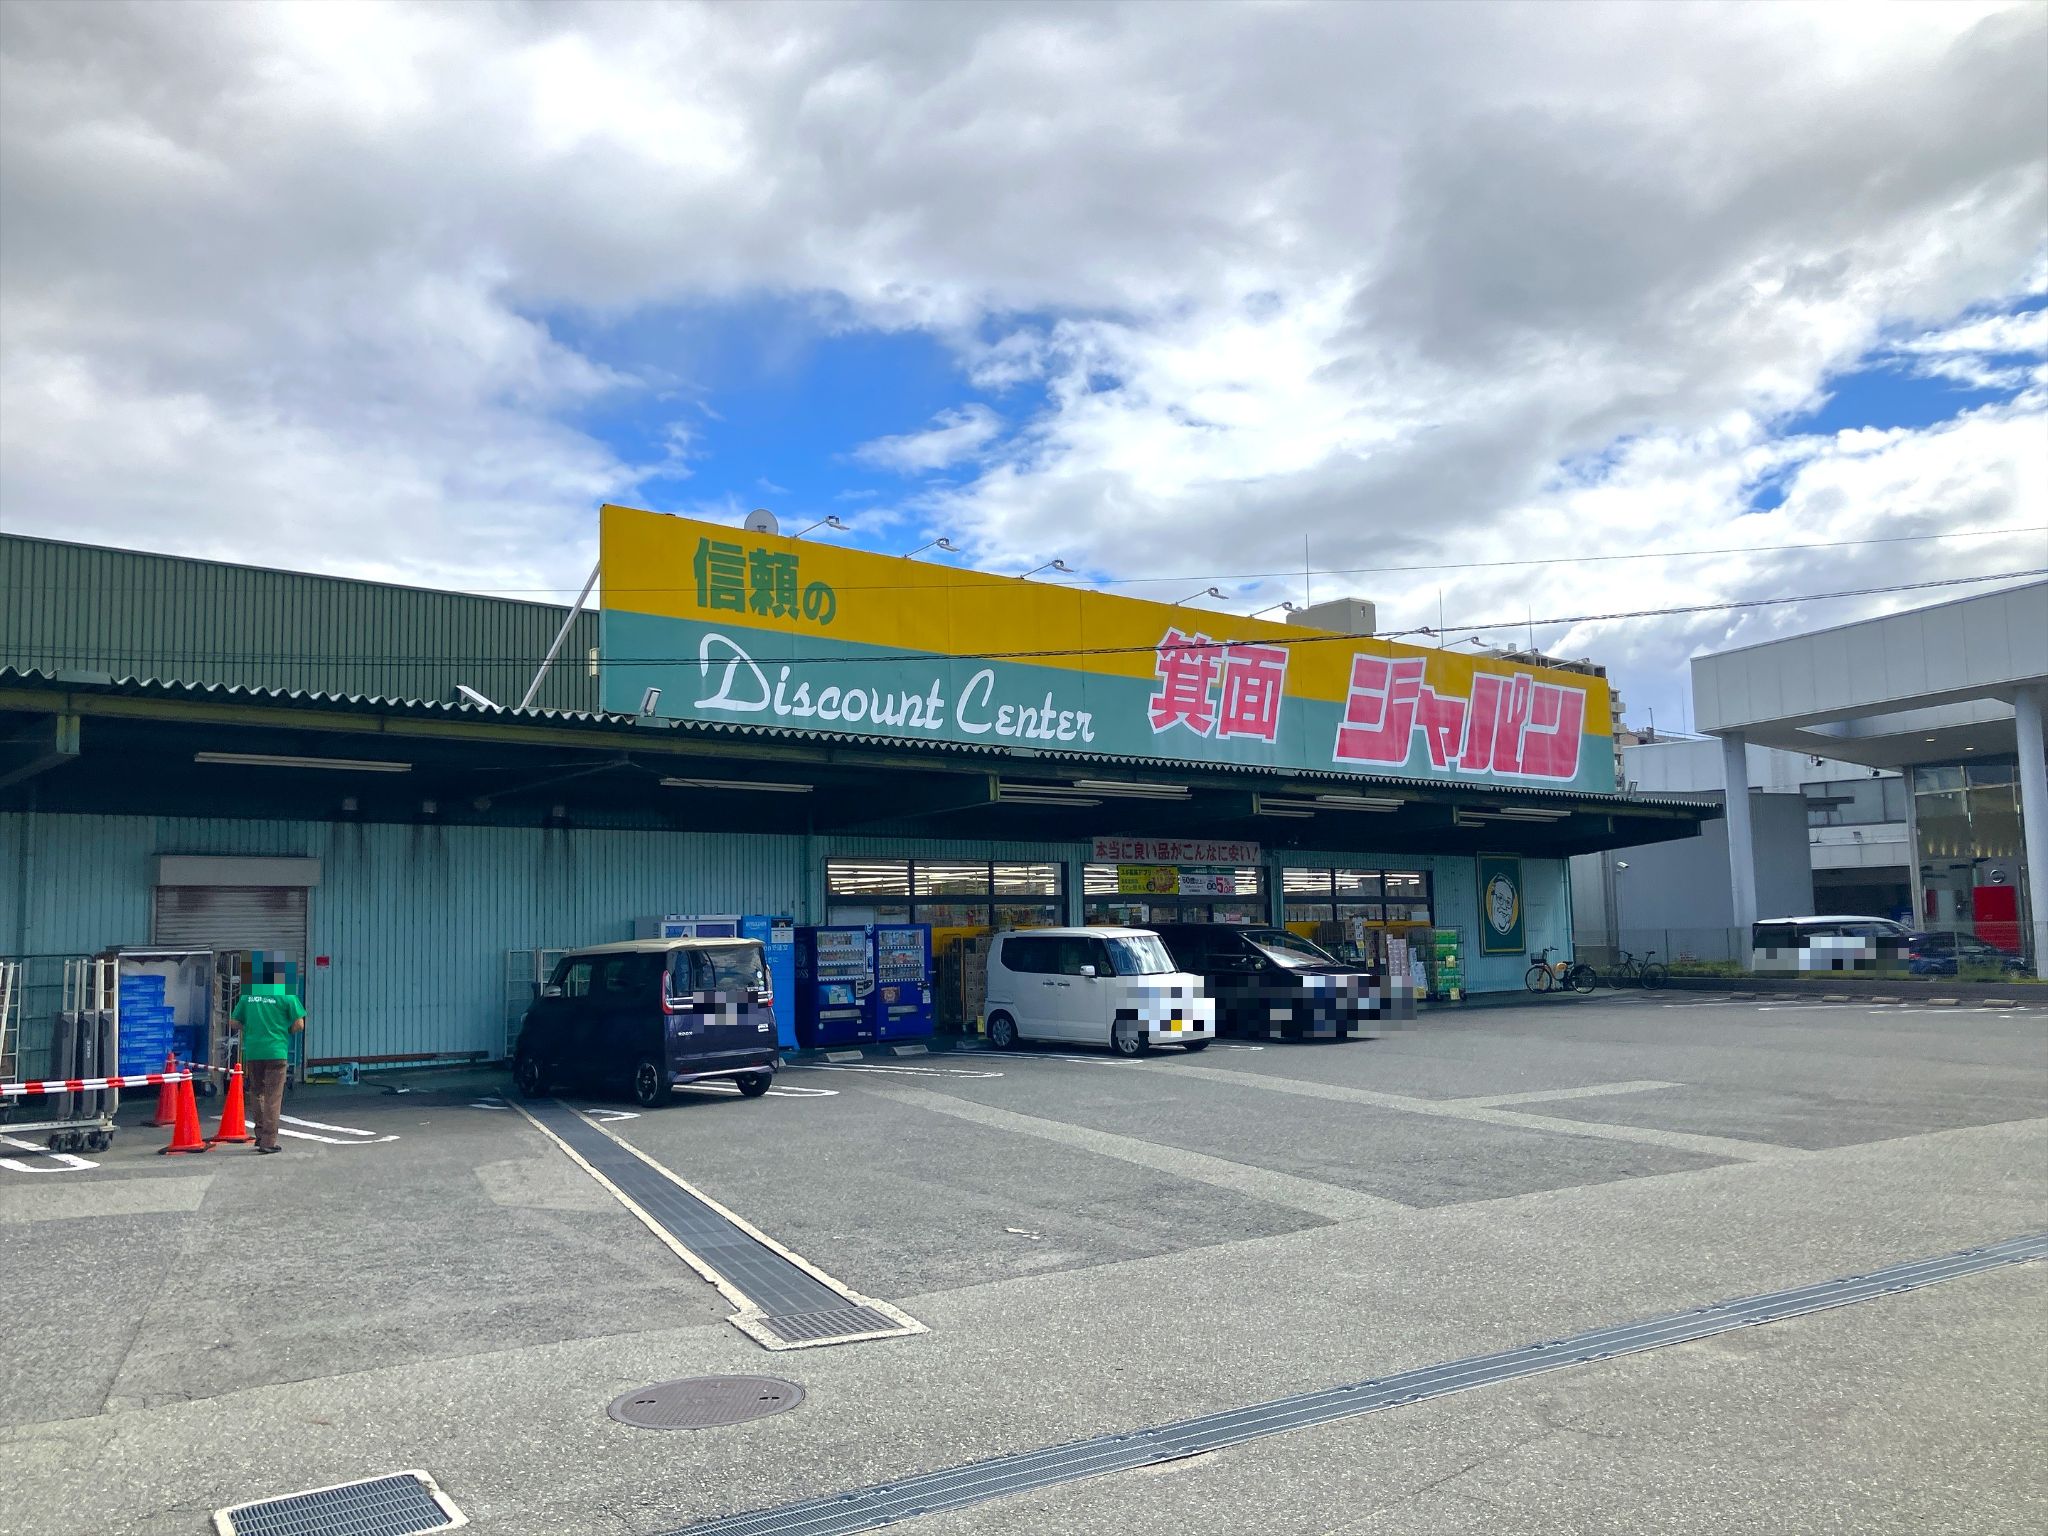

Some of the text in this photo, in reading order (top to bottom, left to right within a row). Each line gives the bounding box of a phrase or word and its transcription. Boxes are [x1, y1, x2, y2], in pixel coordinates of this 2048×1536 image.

[693, 537, 837, 625] 信頼の
[694, 632, 1095, 743] Discount Center
[1147, 626, 1587, 783] 箕面 ジャパン
